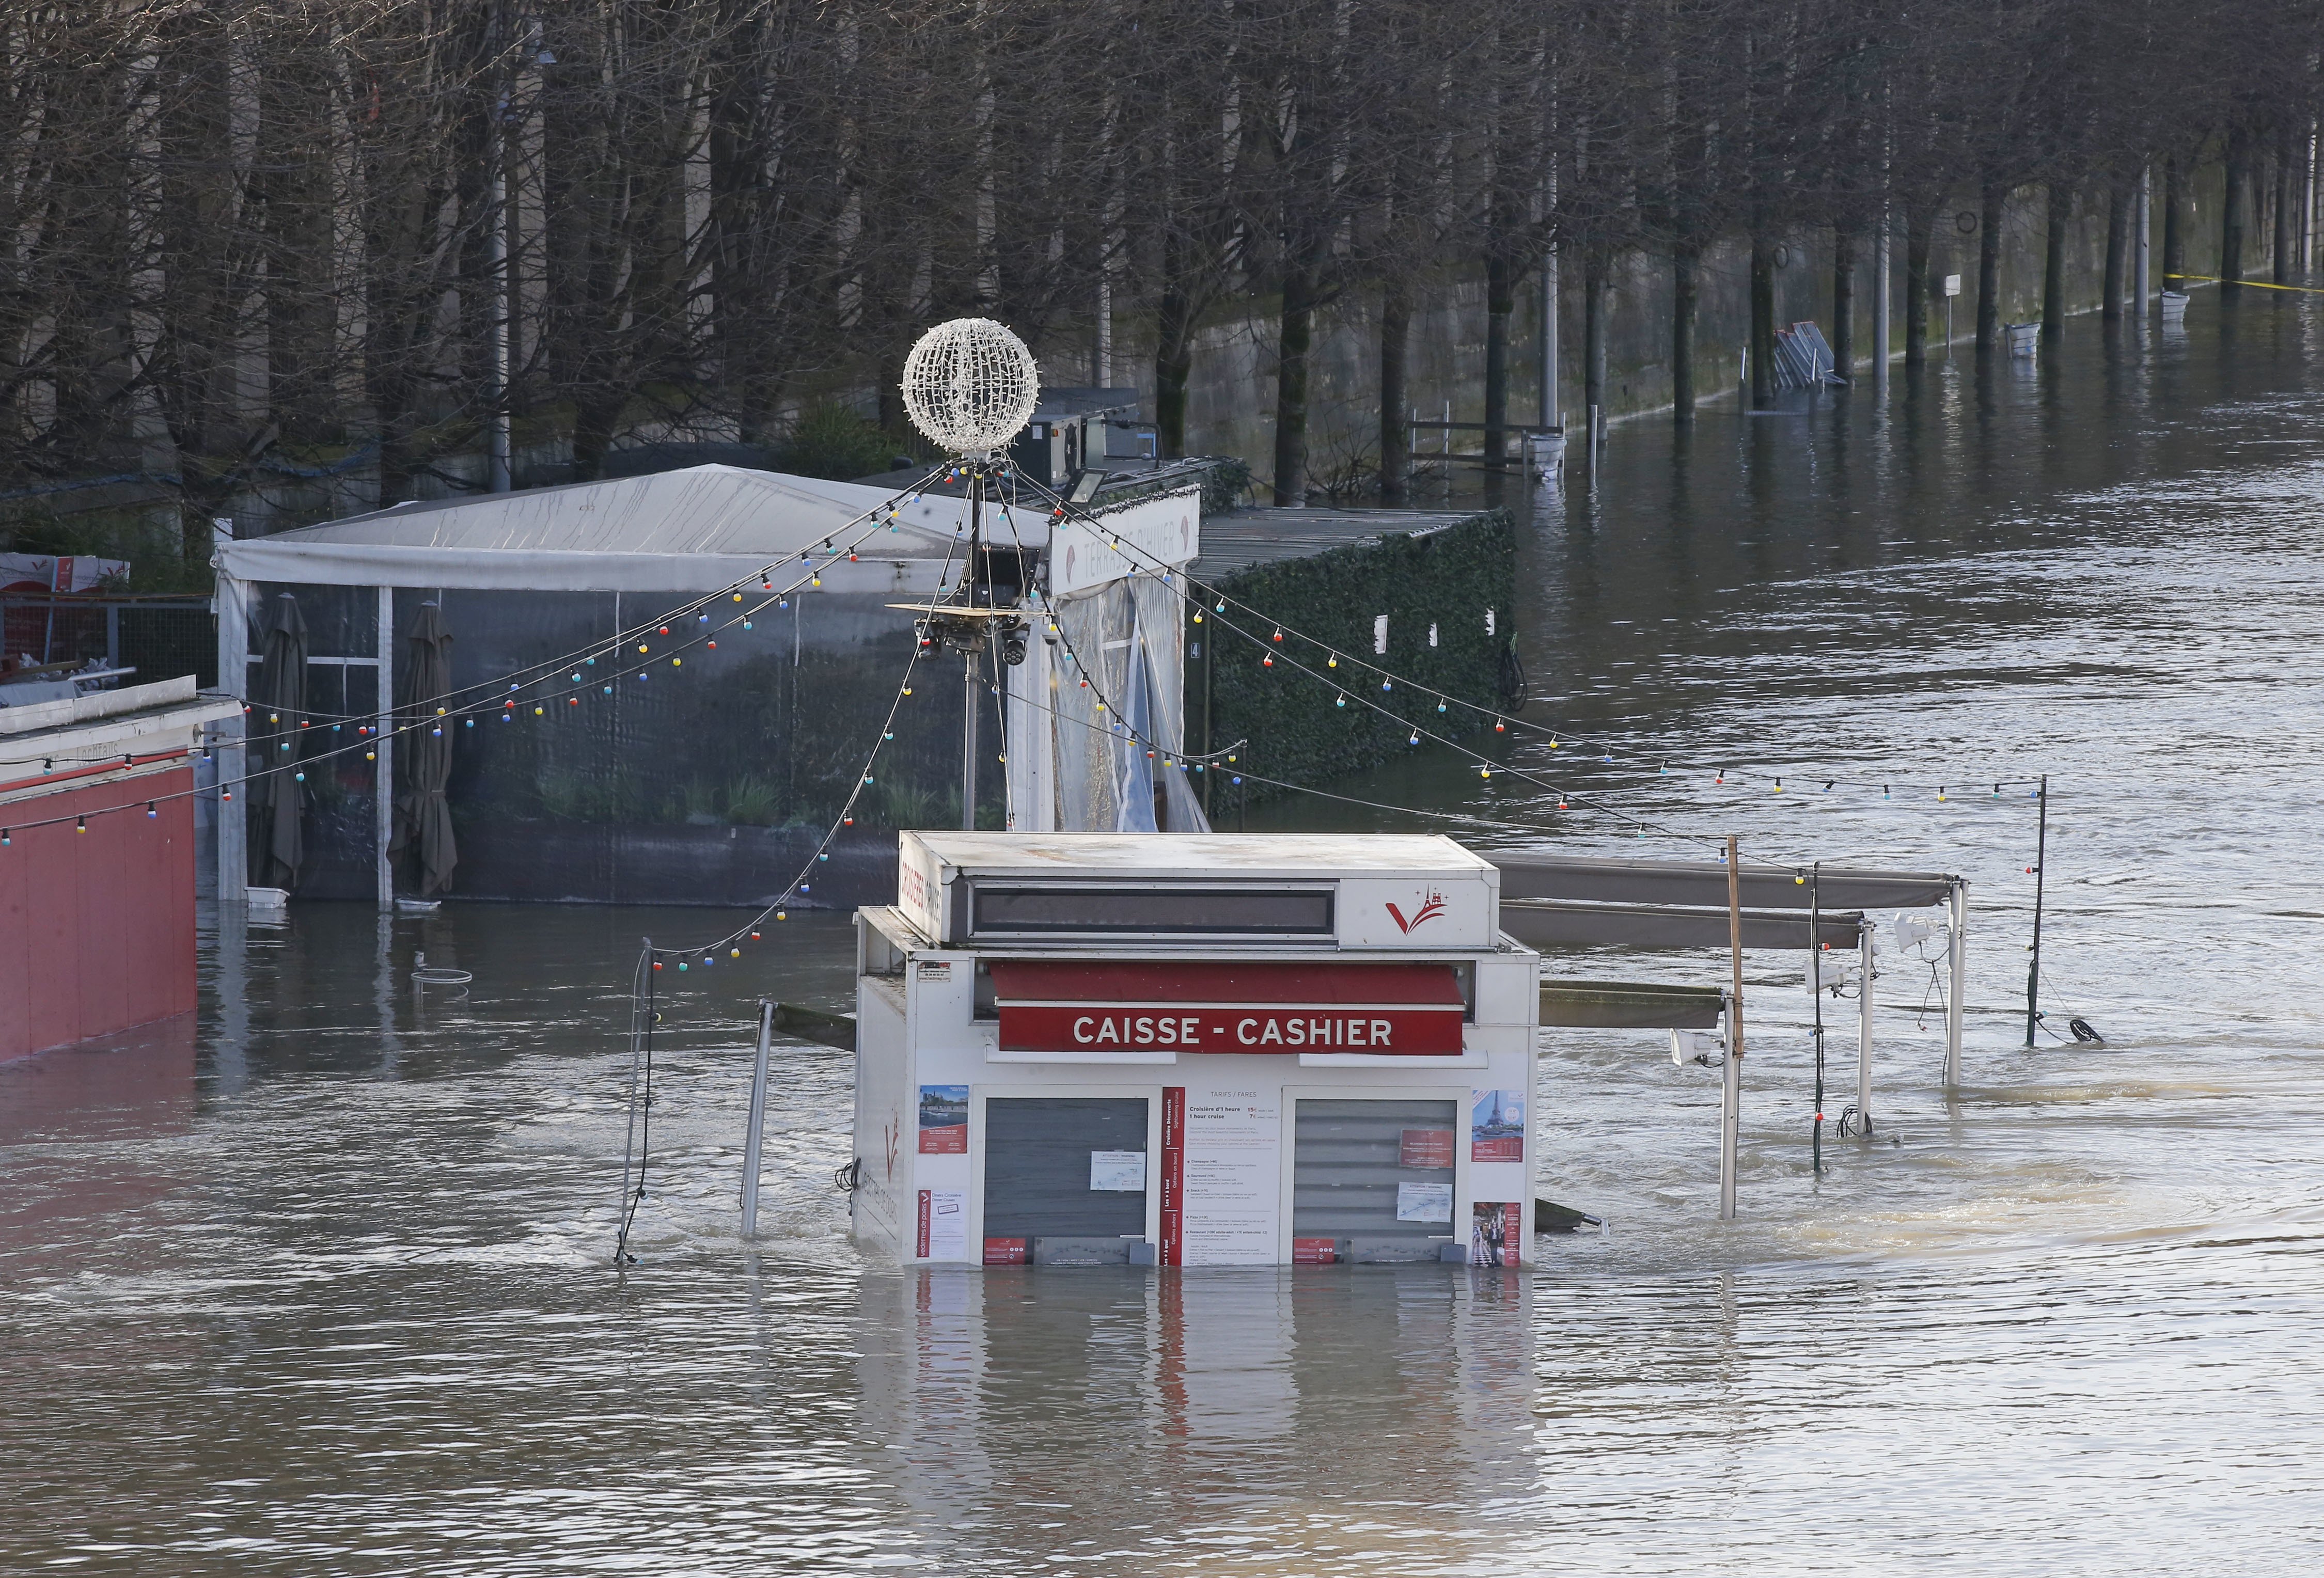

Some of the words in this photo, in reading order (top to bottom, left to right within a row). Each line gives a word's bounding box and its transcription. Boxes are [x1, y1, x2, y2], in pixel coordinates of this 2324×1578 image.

[1084, 531, 1133, 578] TERRASSE
[1137, 520, 1174, 564] D'HIVER
[1192, 644, 1198, 657] 4
[1073, 1016, 1200, 1045] CAISSE
[1237, 1017, 1392, 1047] CASHIER
[921, 1220, 927, 1228] de
